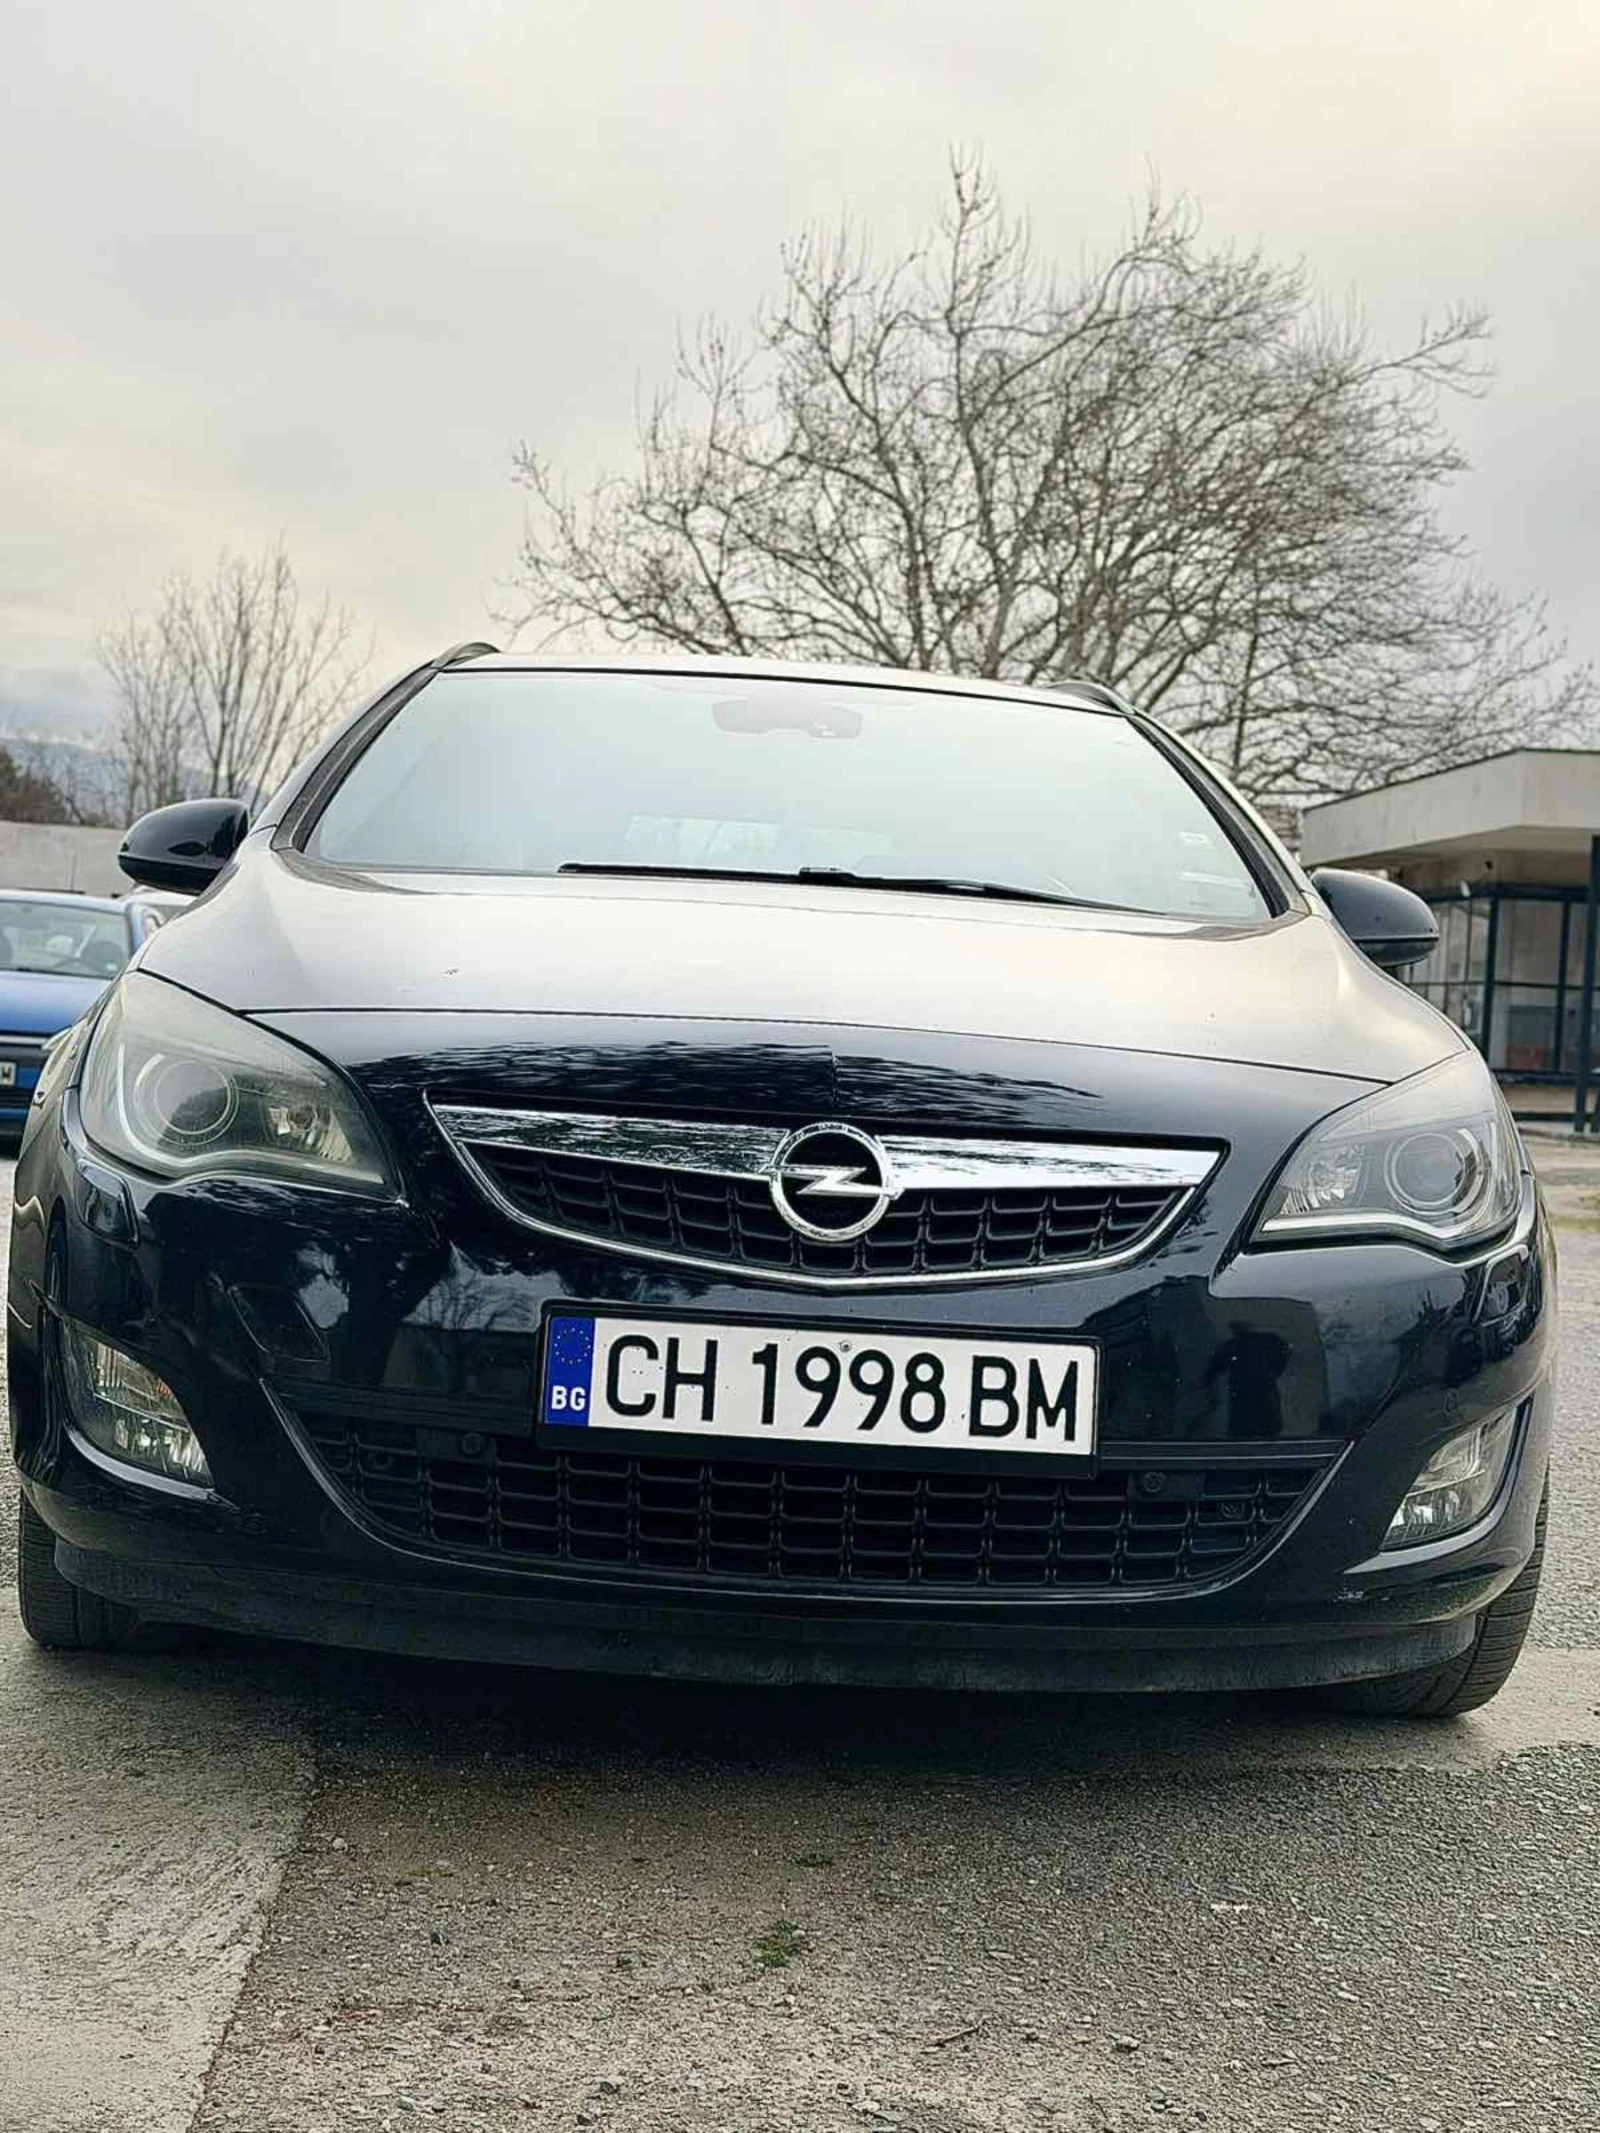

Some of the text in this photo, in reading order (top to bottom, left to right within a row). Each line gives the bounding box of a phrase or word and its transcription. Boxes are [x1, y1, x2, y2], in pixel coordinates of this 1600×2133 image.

[552, 1385, 586, 1411] BG
[606, 1335, 1078, 1442] CH 1998 BM
